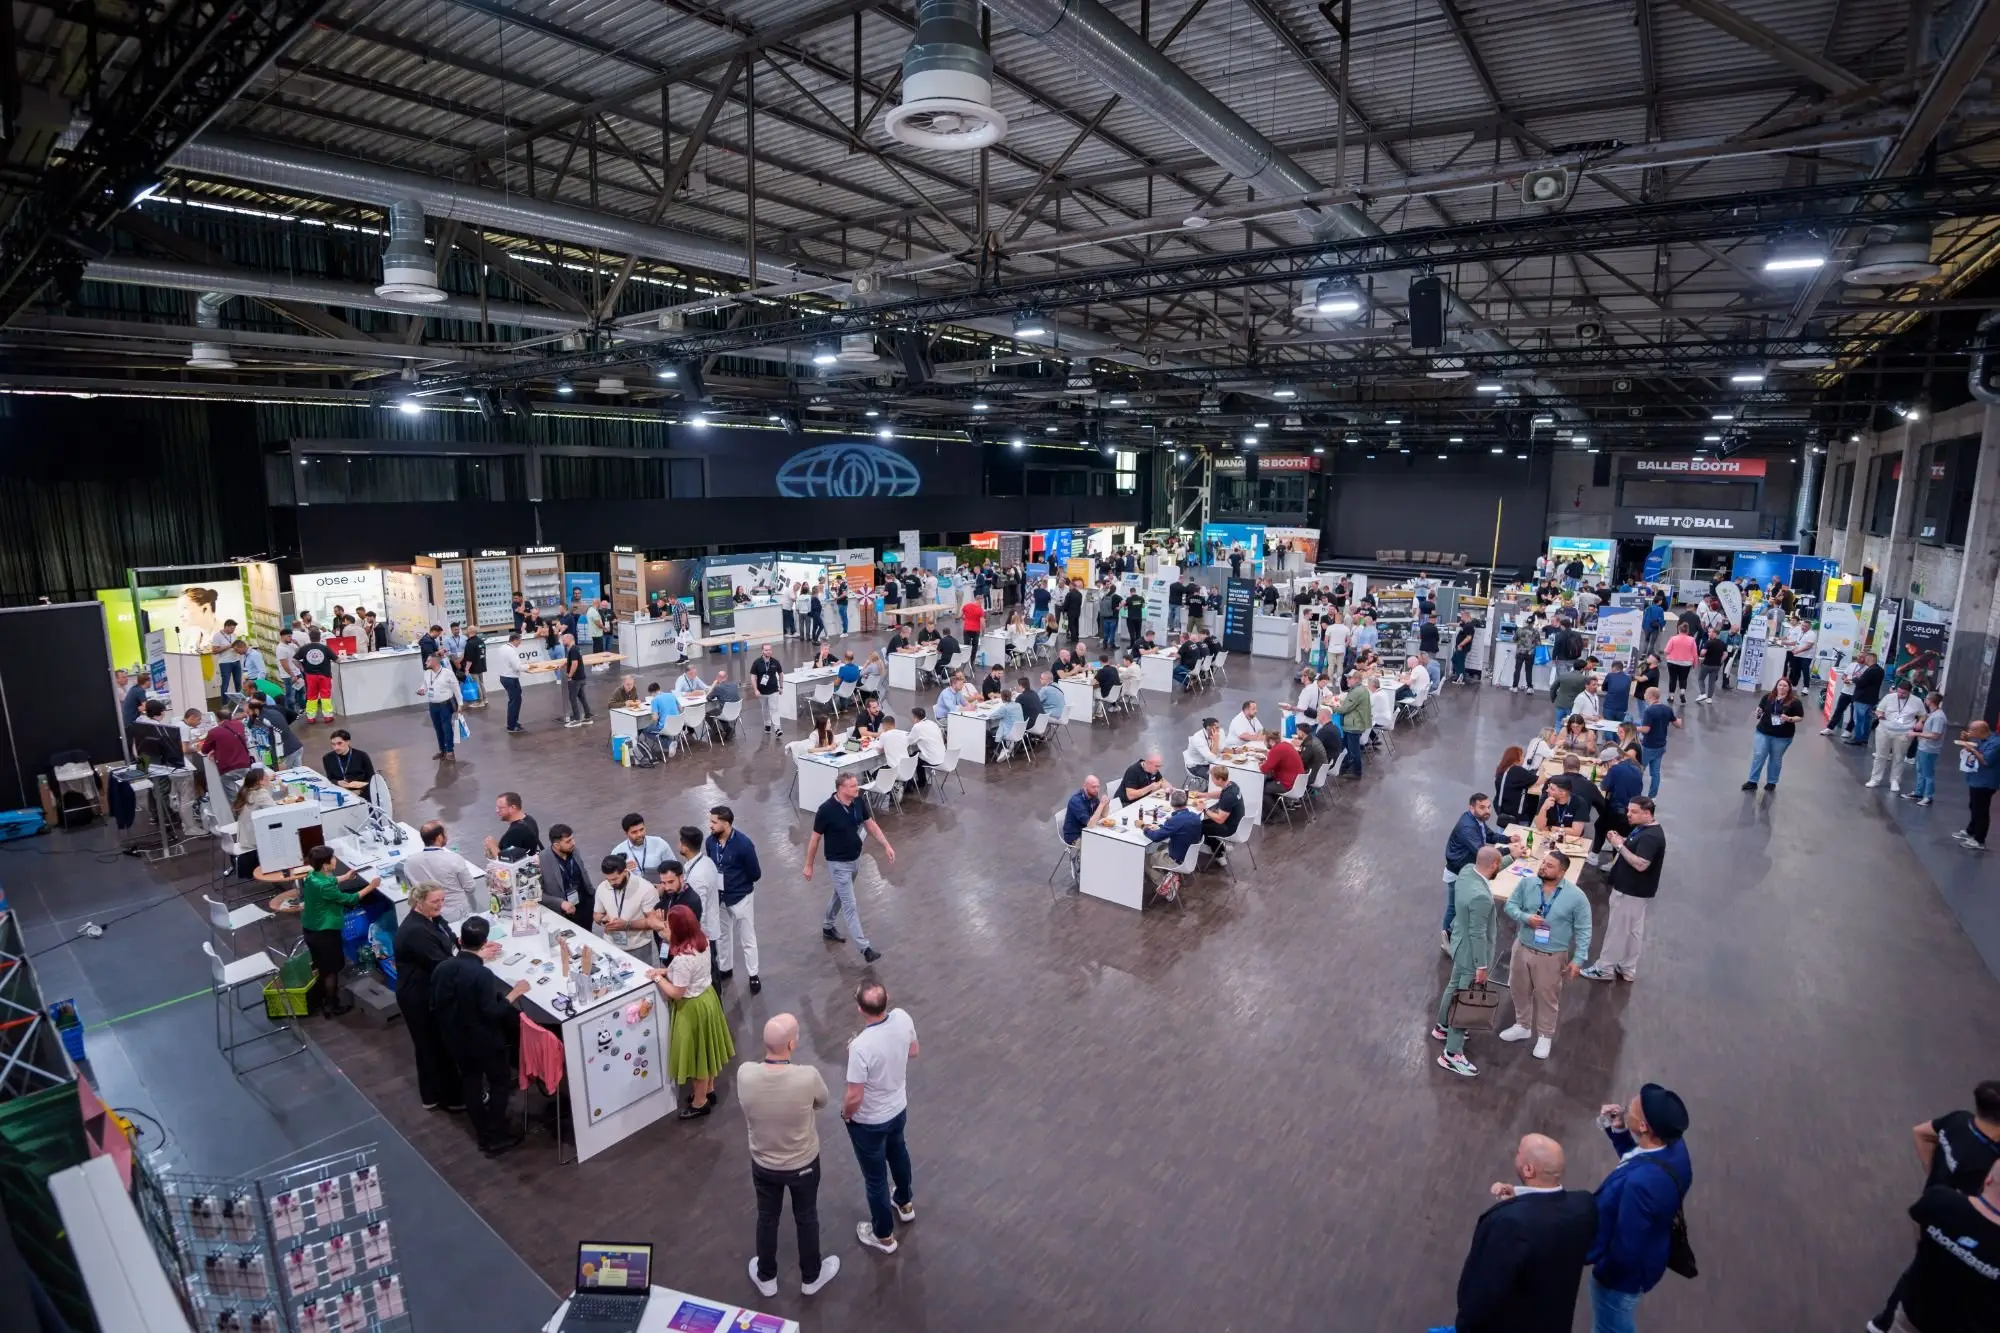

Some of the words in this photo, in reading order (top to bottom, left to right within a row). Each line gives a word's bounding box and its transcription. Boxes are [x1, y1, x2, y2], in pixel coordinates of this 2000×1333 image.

[1215, 459, 1270, 468] MANARS
[1271, 458, 1308, 467] BOOTH
[1637, 460, 1688, 471] BALLER
[1690, 461, 1740, 472] BOOTH
[1635, 515, 1669, 526] TIME
[1694, 518, 1734, 529] BALL
